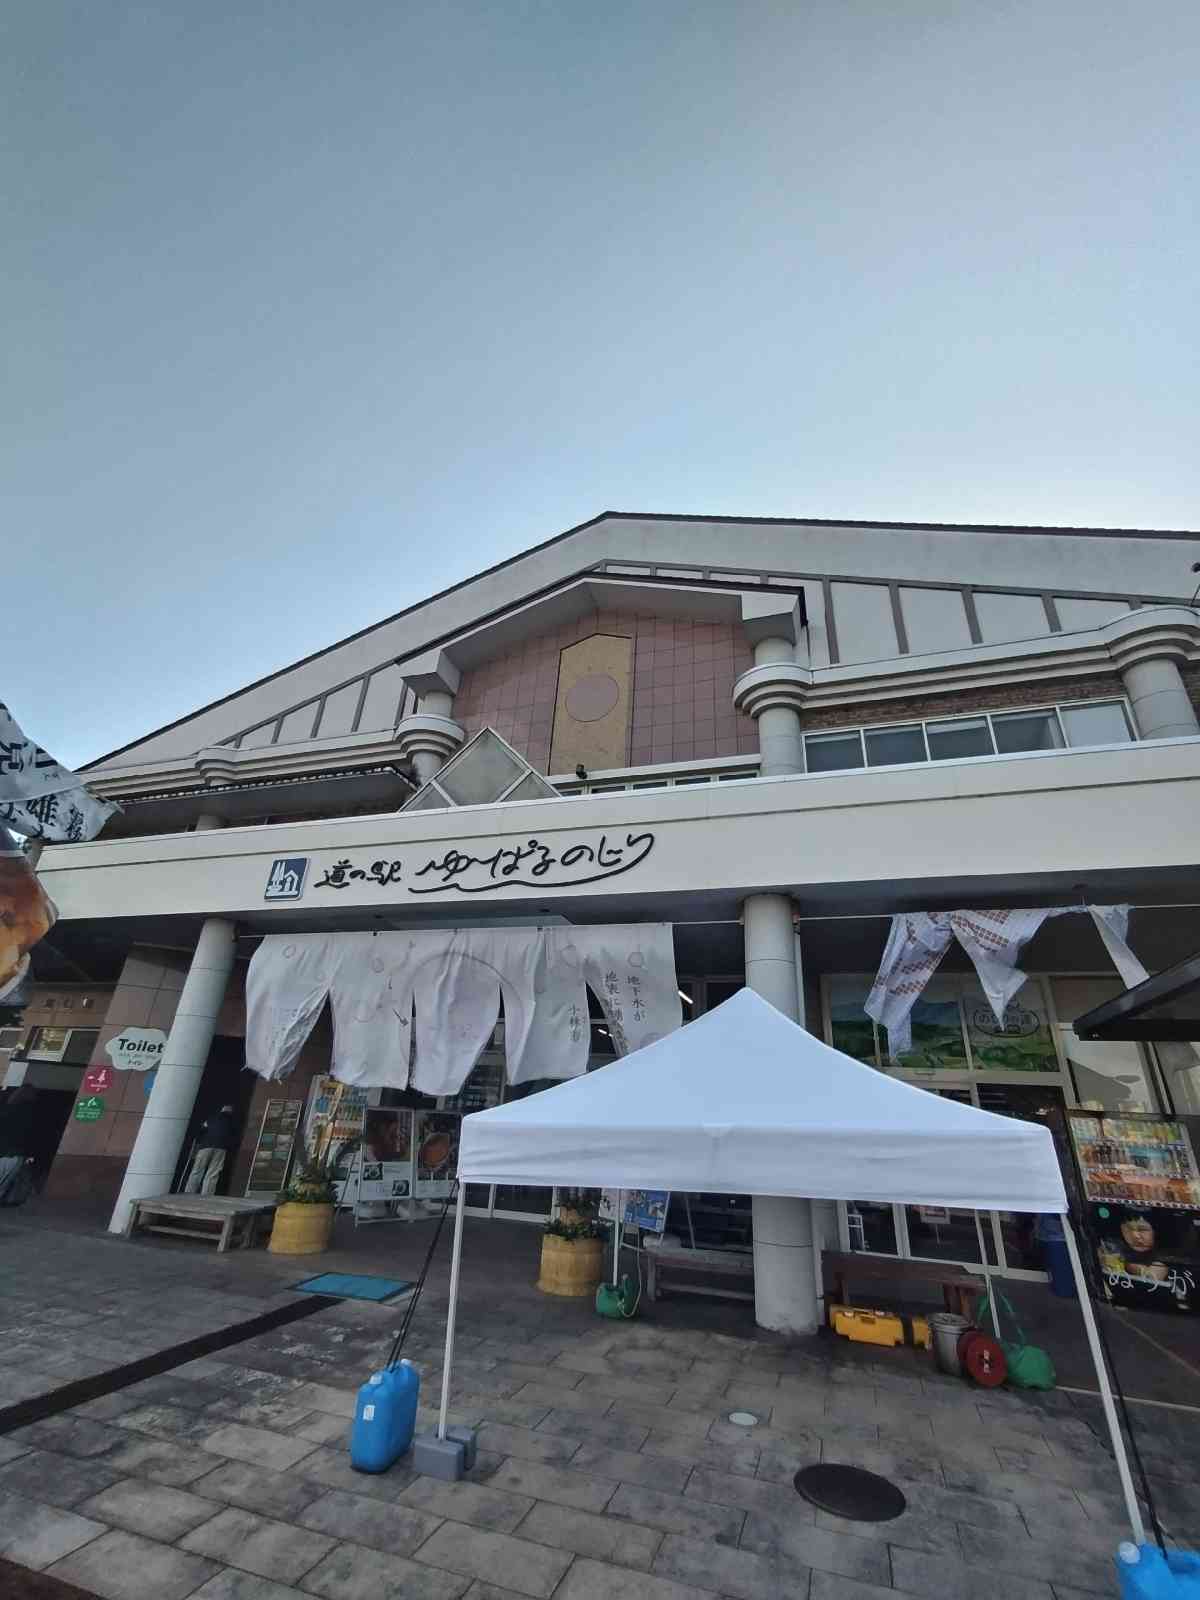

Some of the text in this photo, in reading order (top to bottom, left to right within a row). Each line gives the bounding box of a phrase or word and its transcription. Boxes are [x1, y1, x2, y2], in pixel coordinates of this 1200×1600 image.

[314, 860, 402, 889] 道の駅
[118, 1038, 164, 1054] Toilet
